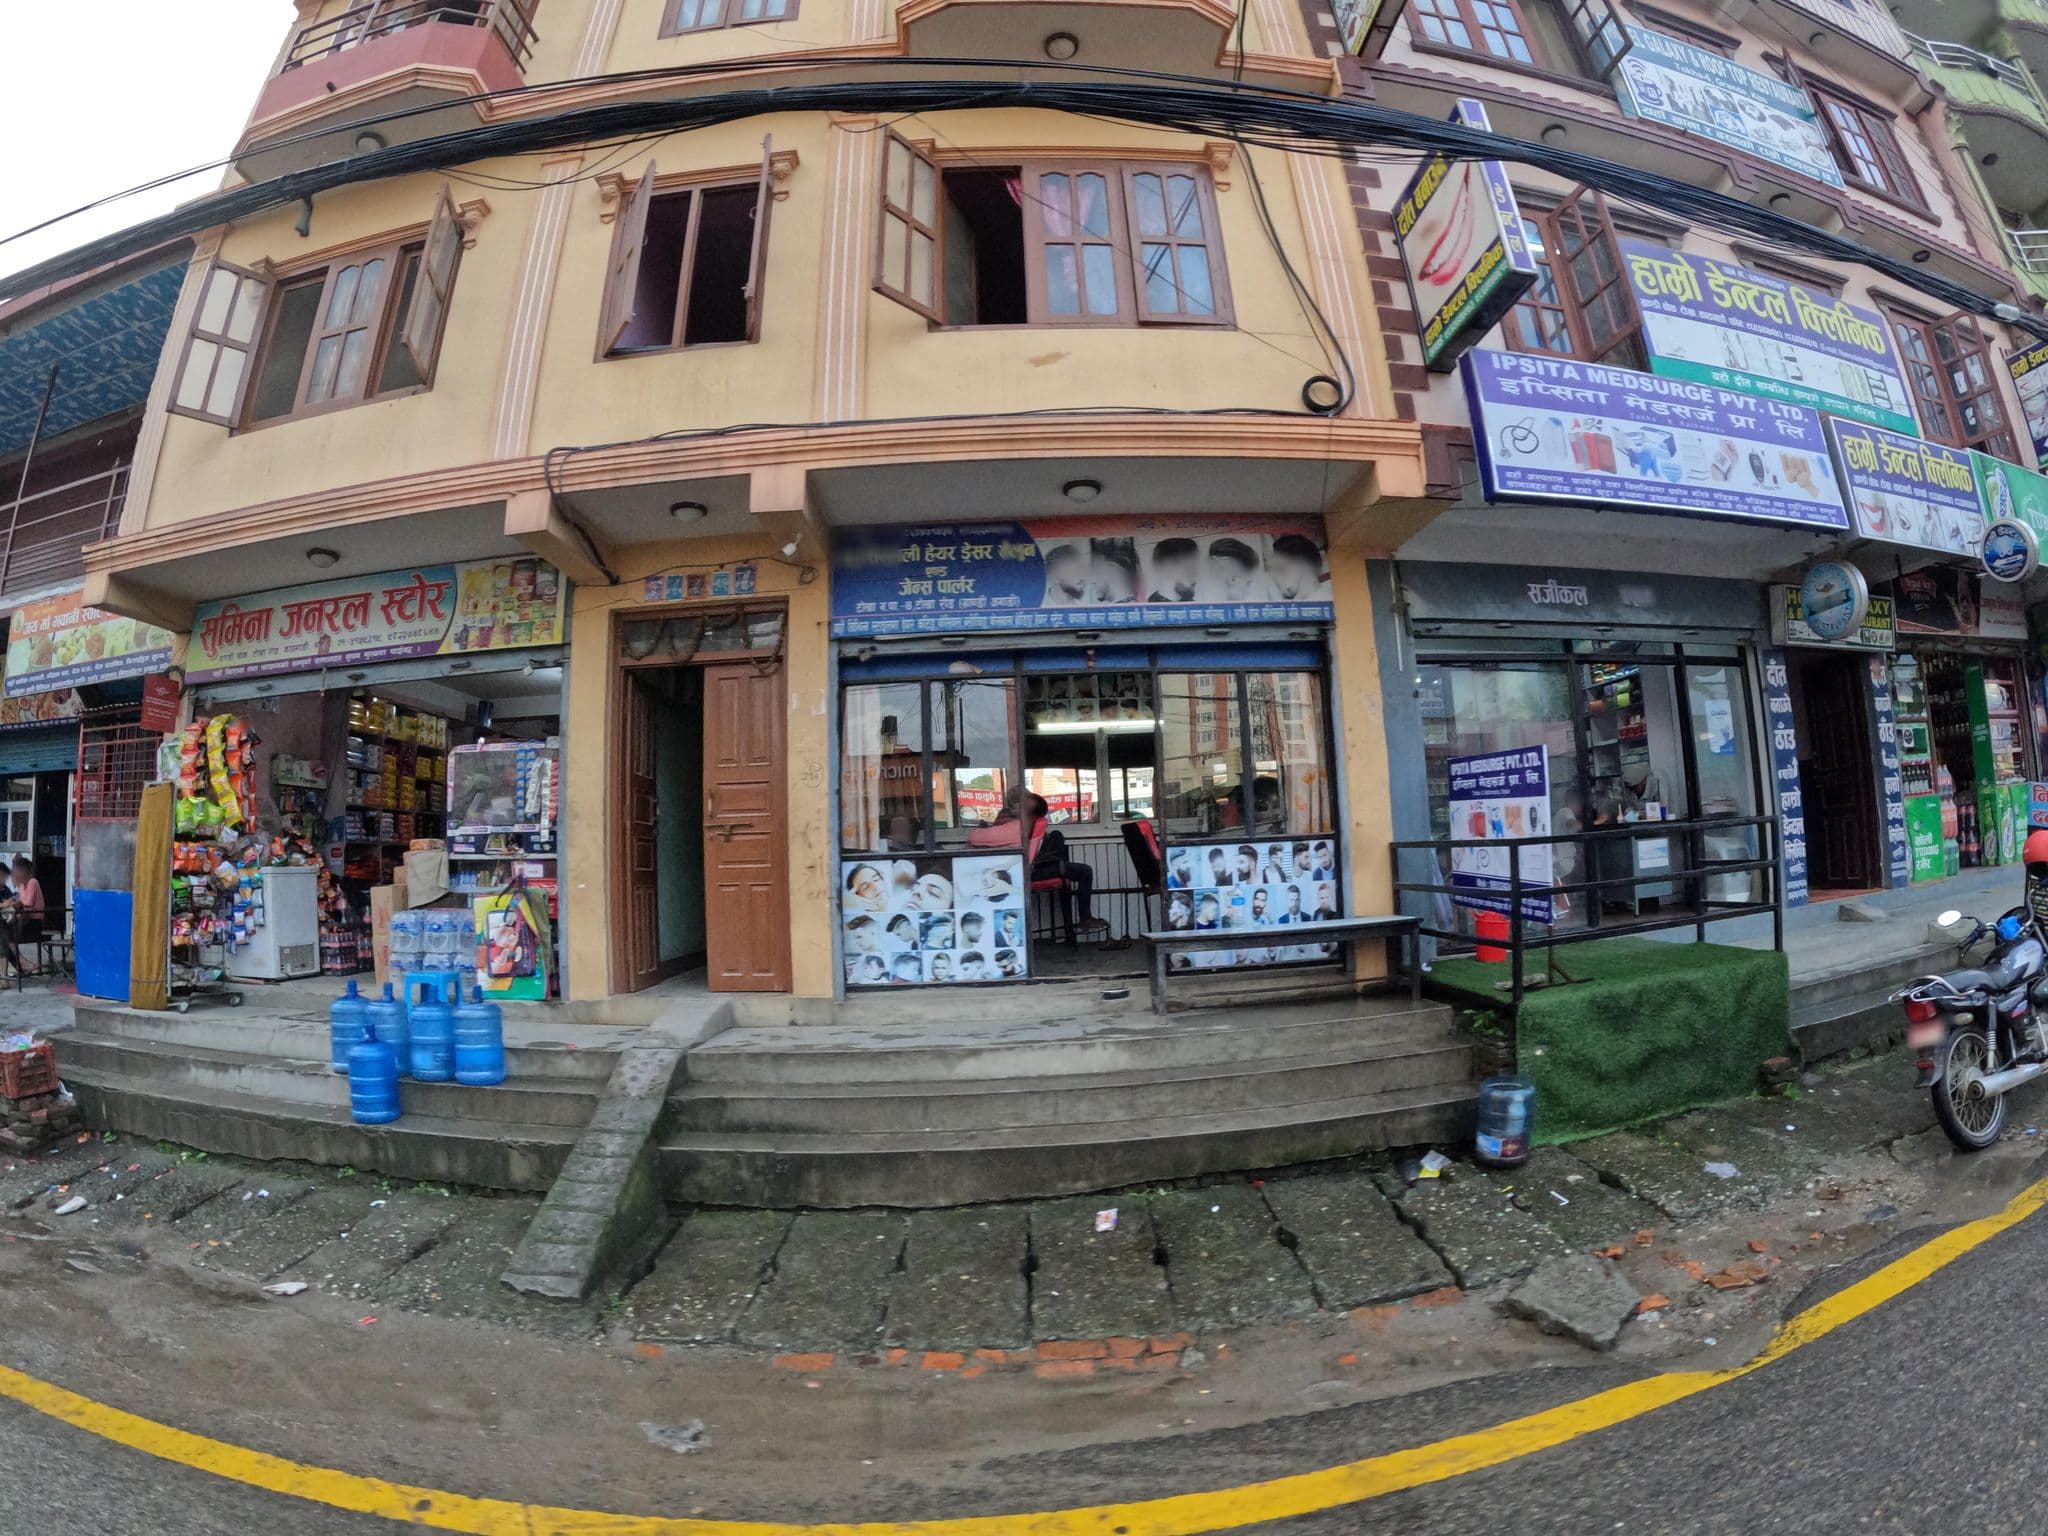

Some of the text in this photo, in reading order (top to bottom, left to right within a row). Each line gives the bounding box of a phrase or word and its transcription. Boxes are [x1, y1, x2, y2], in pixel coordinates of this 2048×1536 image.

[1641, 31, 1692, 64] GALAXY
[1698, 52, 1729, 78] ROOF
[1728, 62, 1751, 86] TOP
[1626, 253, 1887, 355] हाम्रो डेन्टल क्लिनिक
[1491, 354, 1809, 424] IPSITA MEDSURGE PVT. LTD.
[1497, 376, 1609, 407] इप्सिता
[1623, 391, 1717, 424] मेडसर्ज
[1841, 430, 1880, 474] हाम्रो
[1878, 433, 1923, 482] डेन्टल
[1919, 444, 1974, 494] क्लिनिक
[925, 542, 956, 563] हेयर
[960, 540, 994, 564] ड्रेसर
[898, 575, 976, 596] जेन्स पार्लर
[200, 573, 452, 659] सुमिना जनरल स्टोर
